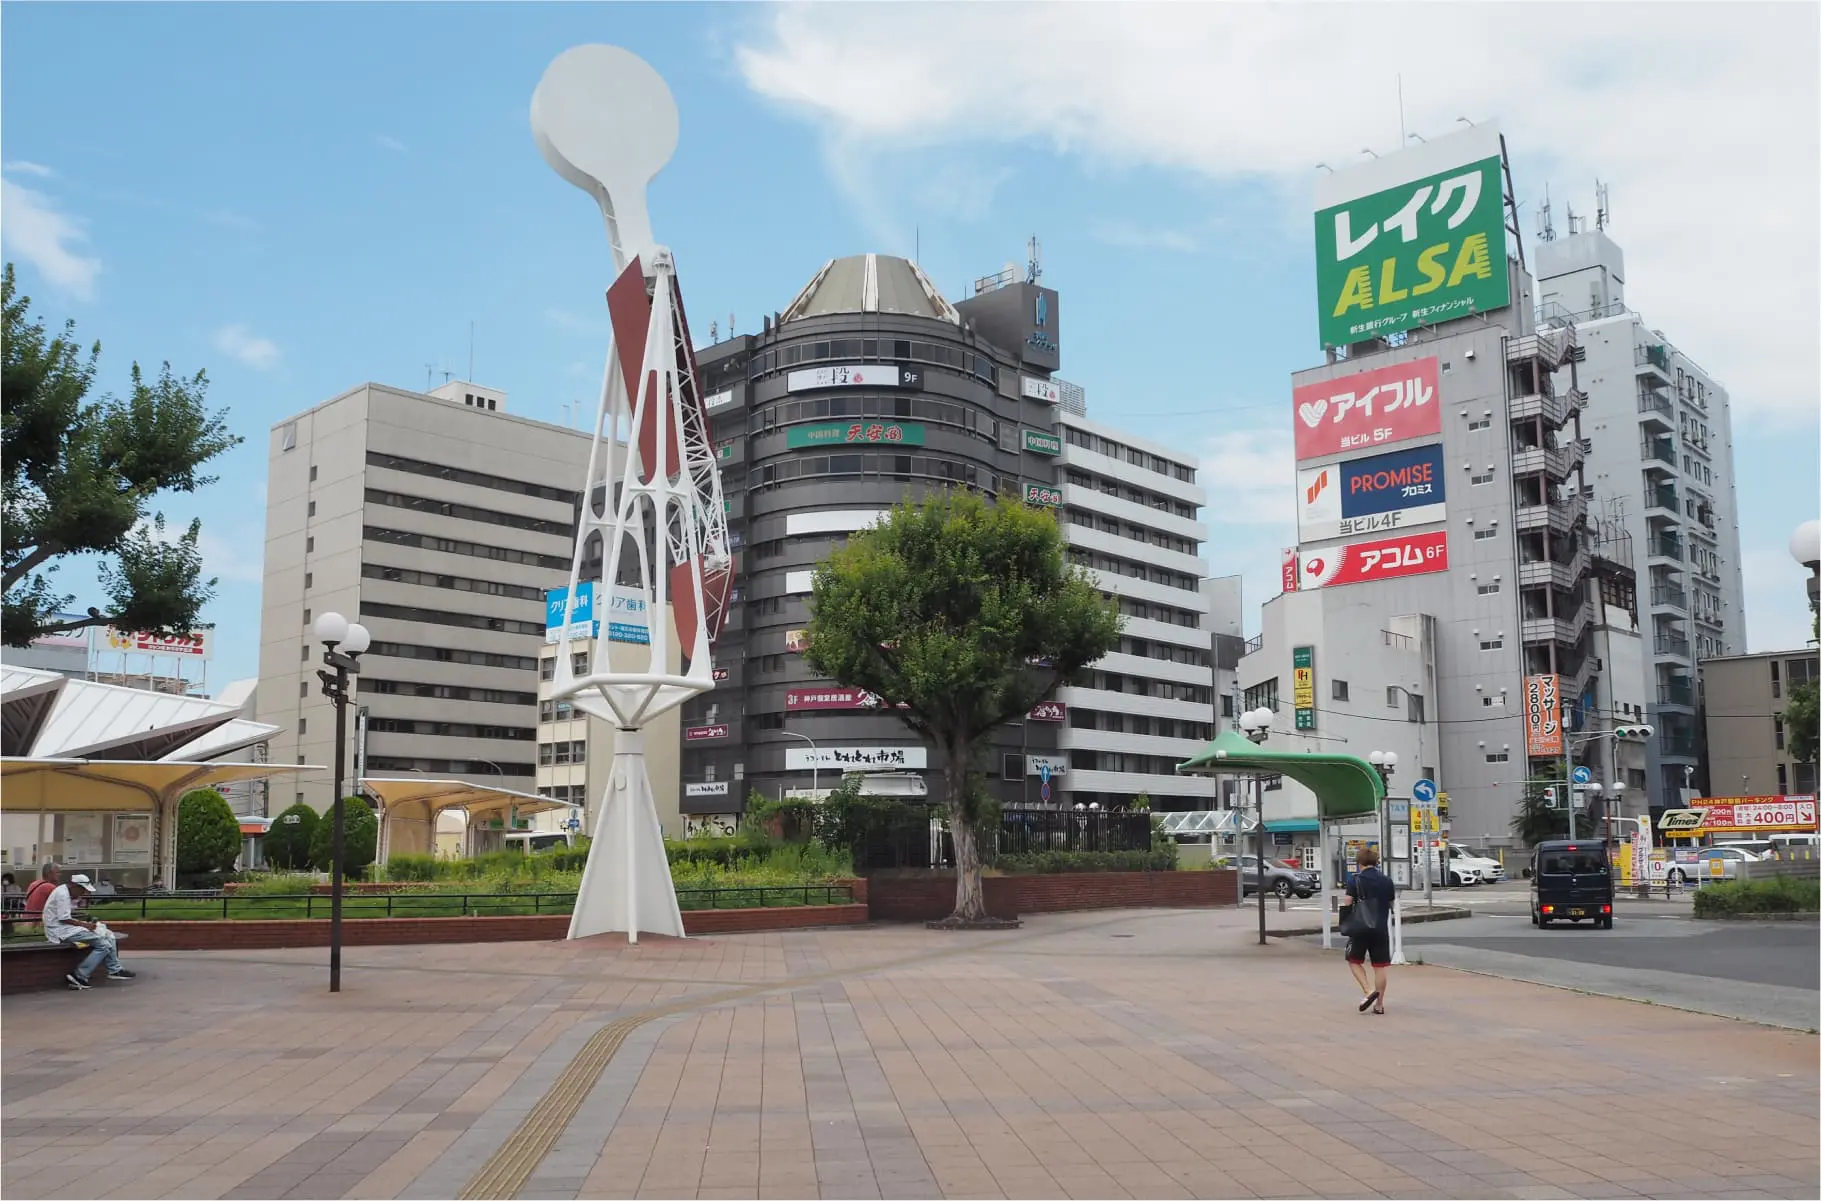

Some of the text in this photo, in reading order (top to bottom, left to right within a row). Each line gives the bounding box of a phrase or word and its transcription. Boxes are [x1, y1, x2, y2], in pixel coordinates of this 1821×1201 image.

[1335, 170, 1482, 262] レイク
[1333, 232, 1492, 318] ALSA
[1350, 297, 1475, 334] 新生銀行グループ 新生フィナンシャル
[904, 371, 918, 383] 9F
[1330, 377, 1433, 424] アイフル
[1341, 428, 1393, 448] 当ビル 5F
[1351, 463, 1433, 495] PROMISE
[1401, 484, 1433, 497] プロミス
[1360, 545, 1445, 573] アコム 6F
[1285, 566, 1294, 589] アコム
[787, 694, 798, 705] 3F
[1529, 683, 1541, 732] 2800円
[1541, 675, 1556, 735] マッサージ
[1666, 814, 1700, 826] Times
[1754, 812, 1795, 823] 400円
